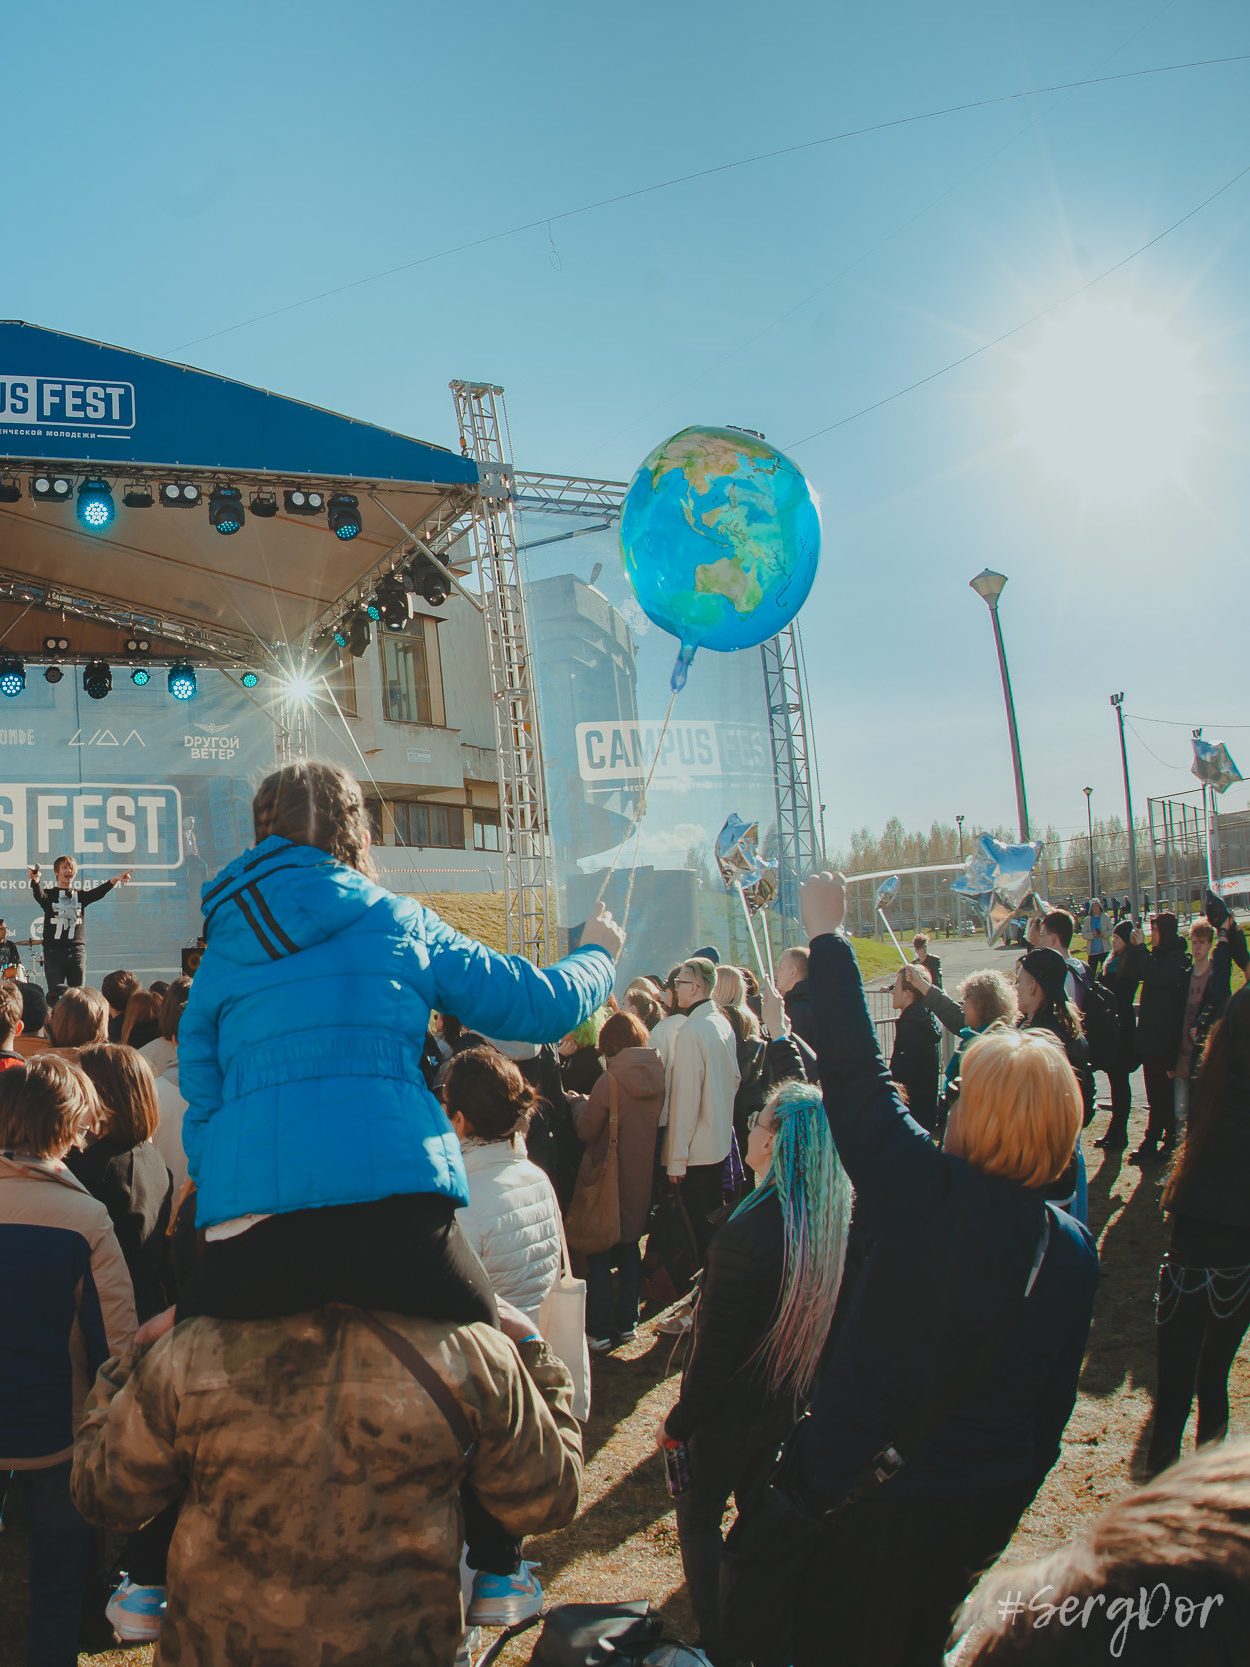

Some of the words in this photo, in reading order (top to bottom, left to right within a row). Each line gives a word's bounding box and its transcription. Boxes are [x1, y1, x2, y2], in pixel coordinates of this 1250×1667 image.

[42, 383, 125, 420] FEST
[45, 431, 97, 439] МОЛОДЕЖИ
[190, 748, 236, 761] ВЕТЕР
[585, 728, 714, 770] CAMPUS
[722, 726, 768, 768] FES
[37, 795, 166, 854] FEST
